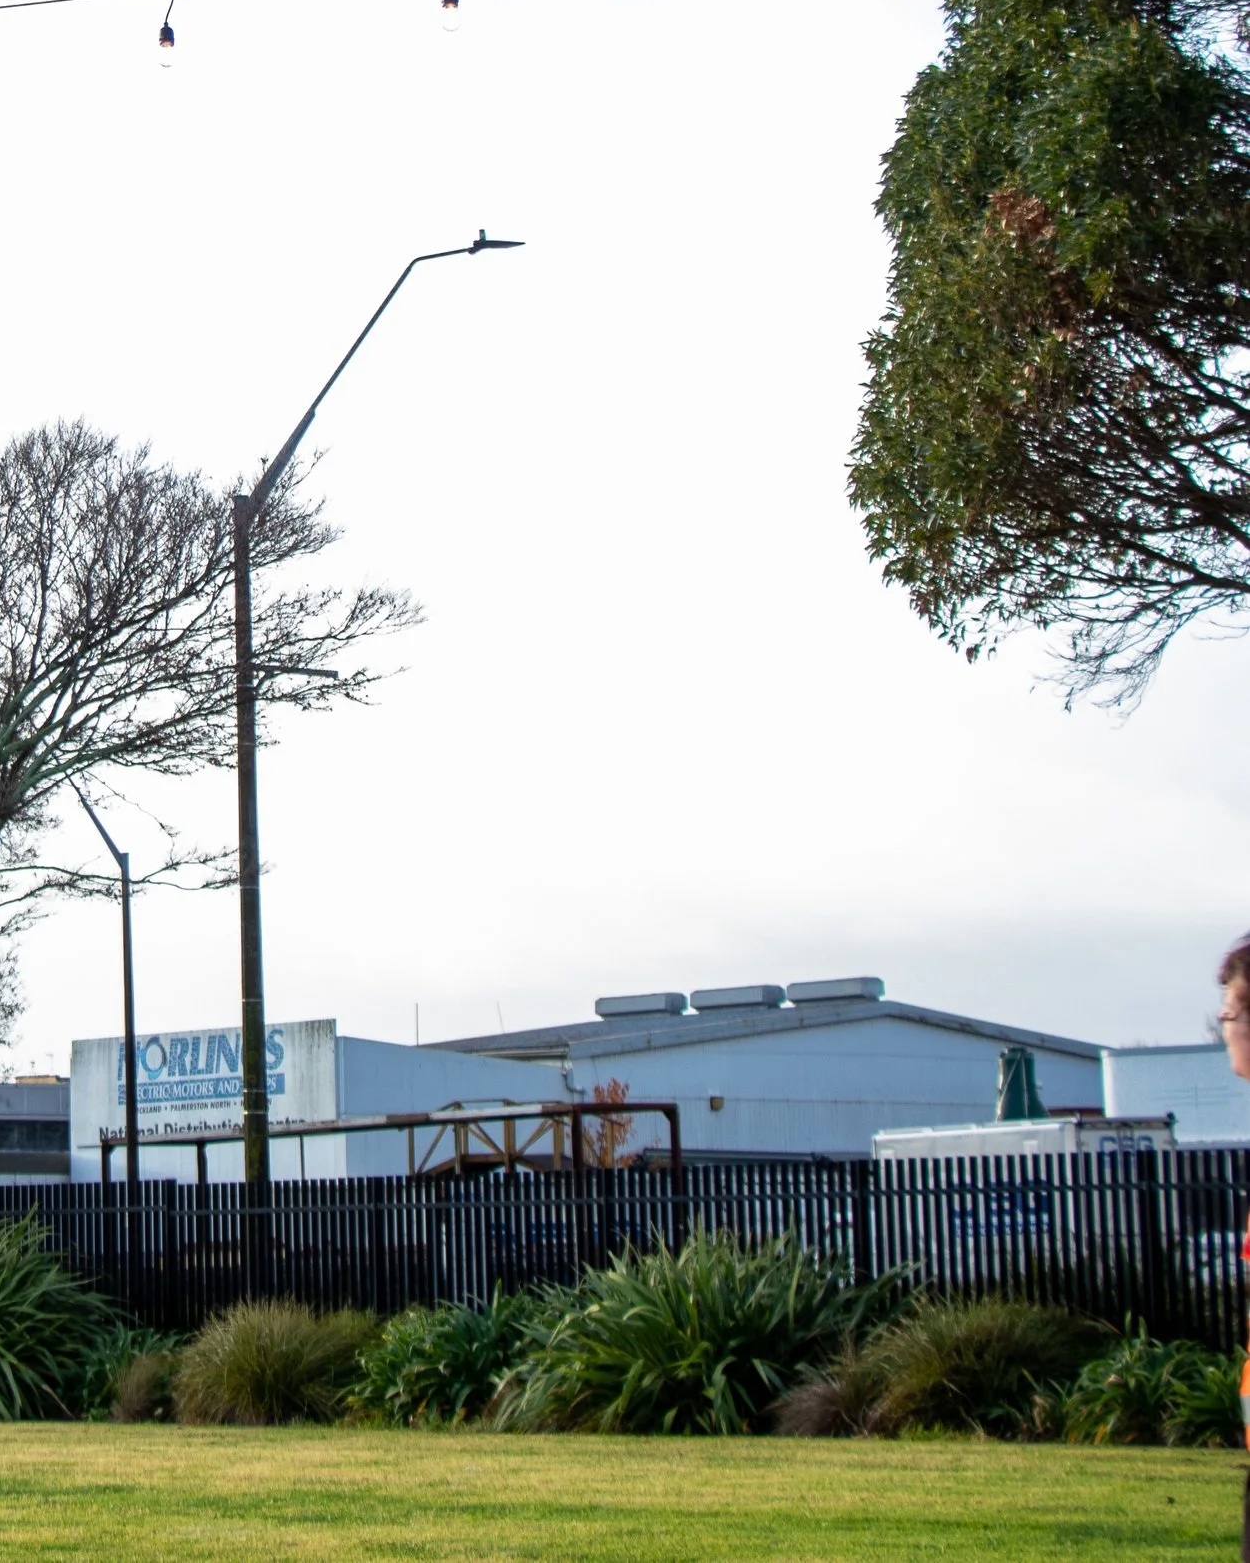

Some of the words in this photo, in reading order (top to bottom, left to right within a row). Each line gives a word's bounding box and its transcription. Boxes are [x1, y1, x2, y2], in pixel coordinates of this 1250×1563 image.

[117, 1029, 285, 1081] ORLINS
[136, 1083, 171, 1100] ECTRIC
[173, 1081, 214, 1097] MOTORS
[217, 1079, 240, 1094] AND
[139, 1105, 161, 1115] CKLAND
[170, 1101, 208, 1112] PALMERSTON
[210, 1100, 231, 1109] NORTH
[99, 1123, 158, 1141] Natinal
